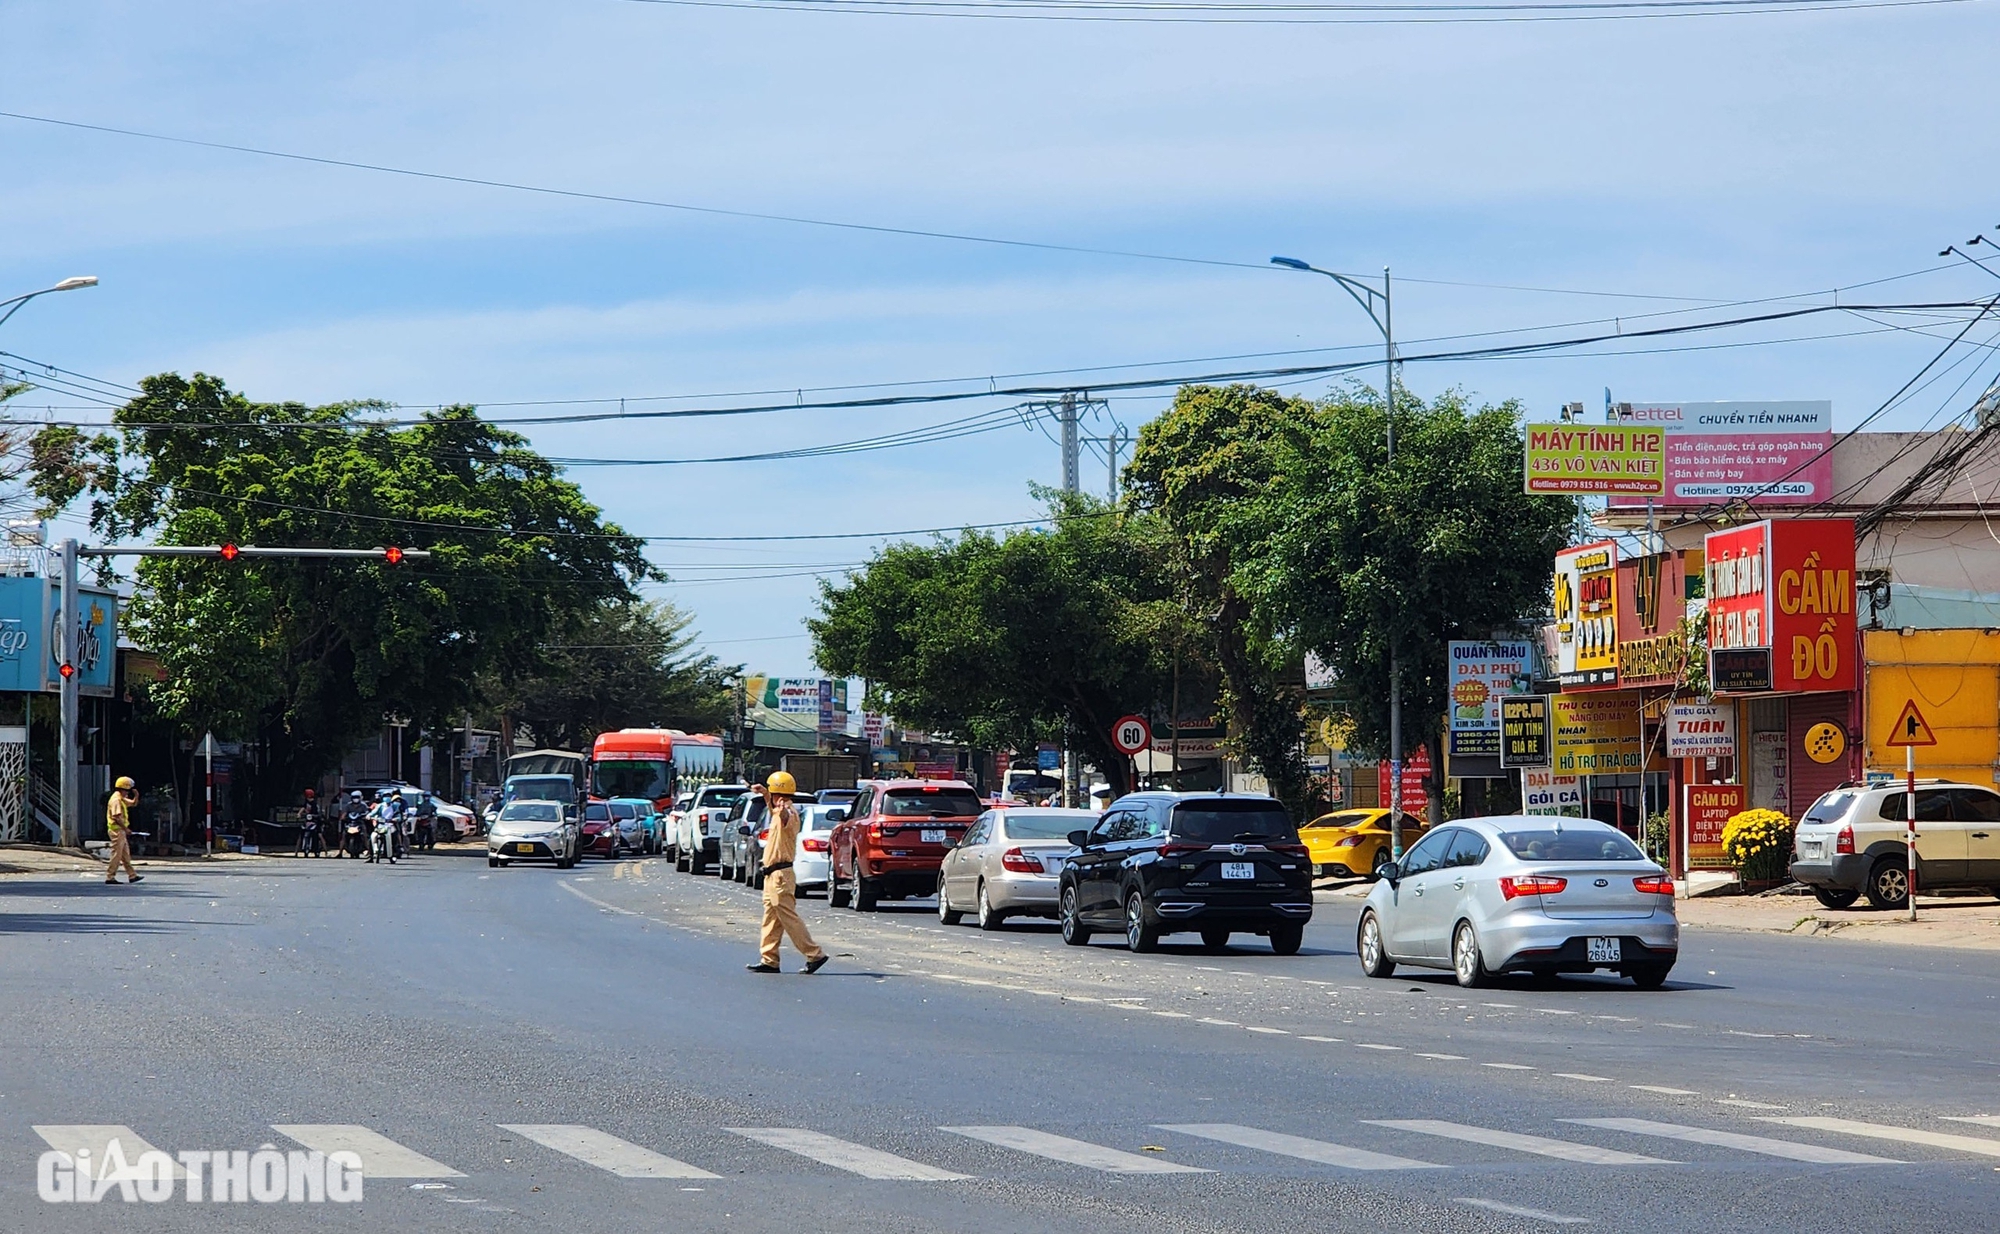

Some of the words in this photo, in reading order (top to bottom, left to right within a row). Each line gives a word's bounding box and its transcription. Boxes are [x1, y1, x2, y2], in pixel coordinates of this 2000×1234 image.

[1699, 410, 1745, 425] CHUYỂN
[1748, 410, 1773, 425] TIỀN
[1777, 413, 1818, 424] NHANH
[1632, 433, 1660, 453] H2
[1758, 442, 1774, 452] góp
[1777, 442, 1798, 452] ngân
[1799, 441, 1823, 452] hàng
[1531, 457, 1560, 471] 436
[1565, 456, 1585, 472] VÕ
[1590, 456, 1620, 473] VĂN
[1626, 456, 1658, 476] KIỆT
[1712, 454, 1733, 464] hiểm
[1769, 456, 1788, 466] máy
[1708, 470, 1725, 480] máy
[1728, 469, 1744, 480] bay
[1560, 481, 1578, 489] 0979
[1580, 481, 1594, 489] 815
[1614, 482, 1658, 491] www.h2pc.vn
[1682, 485, 1721, 495] Hotline:
[1726, 484, 1805, 495] 0974.540.540
[1778, 551, 1849, 615] CẦM
[1454, 644, 1488, 659] QUÁN
[1492, 645, 1526, 661] NHẬU
[1792, 617, 1838, 680] ĐỒ
[1620, 640, 1653, 677] BARBER
[1458, 664, 1486, 678] ĐẠI
[1504, 703, 1543, 719] H2PC.VN
[1558, 702, 1578, 710] THU
[1674, 707, 1694, 716] HIỆU
[1505, 720, 1523, 736] MÁY
[1525, 720, 1543, 736] TÍNH
[1558, 726, 1586, 737] NHẬN
[1123, 728, 1140, 744] 60
[1512, 738, 1525, 753] GIÁ
[1527, 736, 1538, 753] RẺ
[1560, 751, 1574, 770] HỖ
[1577, 755, 1598, 771] TRỢ
[1600, 750, 1620, 768] TRẢ
[1528, 773, 1549, 789] ĐẠI
[1528, 790, 1554, 804] GỎI
[1559, 789, 1580, 802] CÁ
[1693, 790, 1719, 807] CẦM
[1721, 791, 1738, 807] ĐỒ
[1702, 809, 1729, 818] LAPTOP
[1226, 870, 1251, 878] 144.13
[1594, 938, 1612, 949] 47A
[1588, 950, 1619, 961] 269.45
